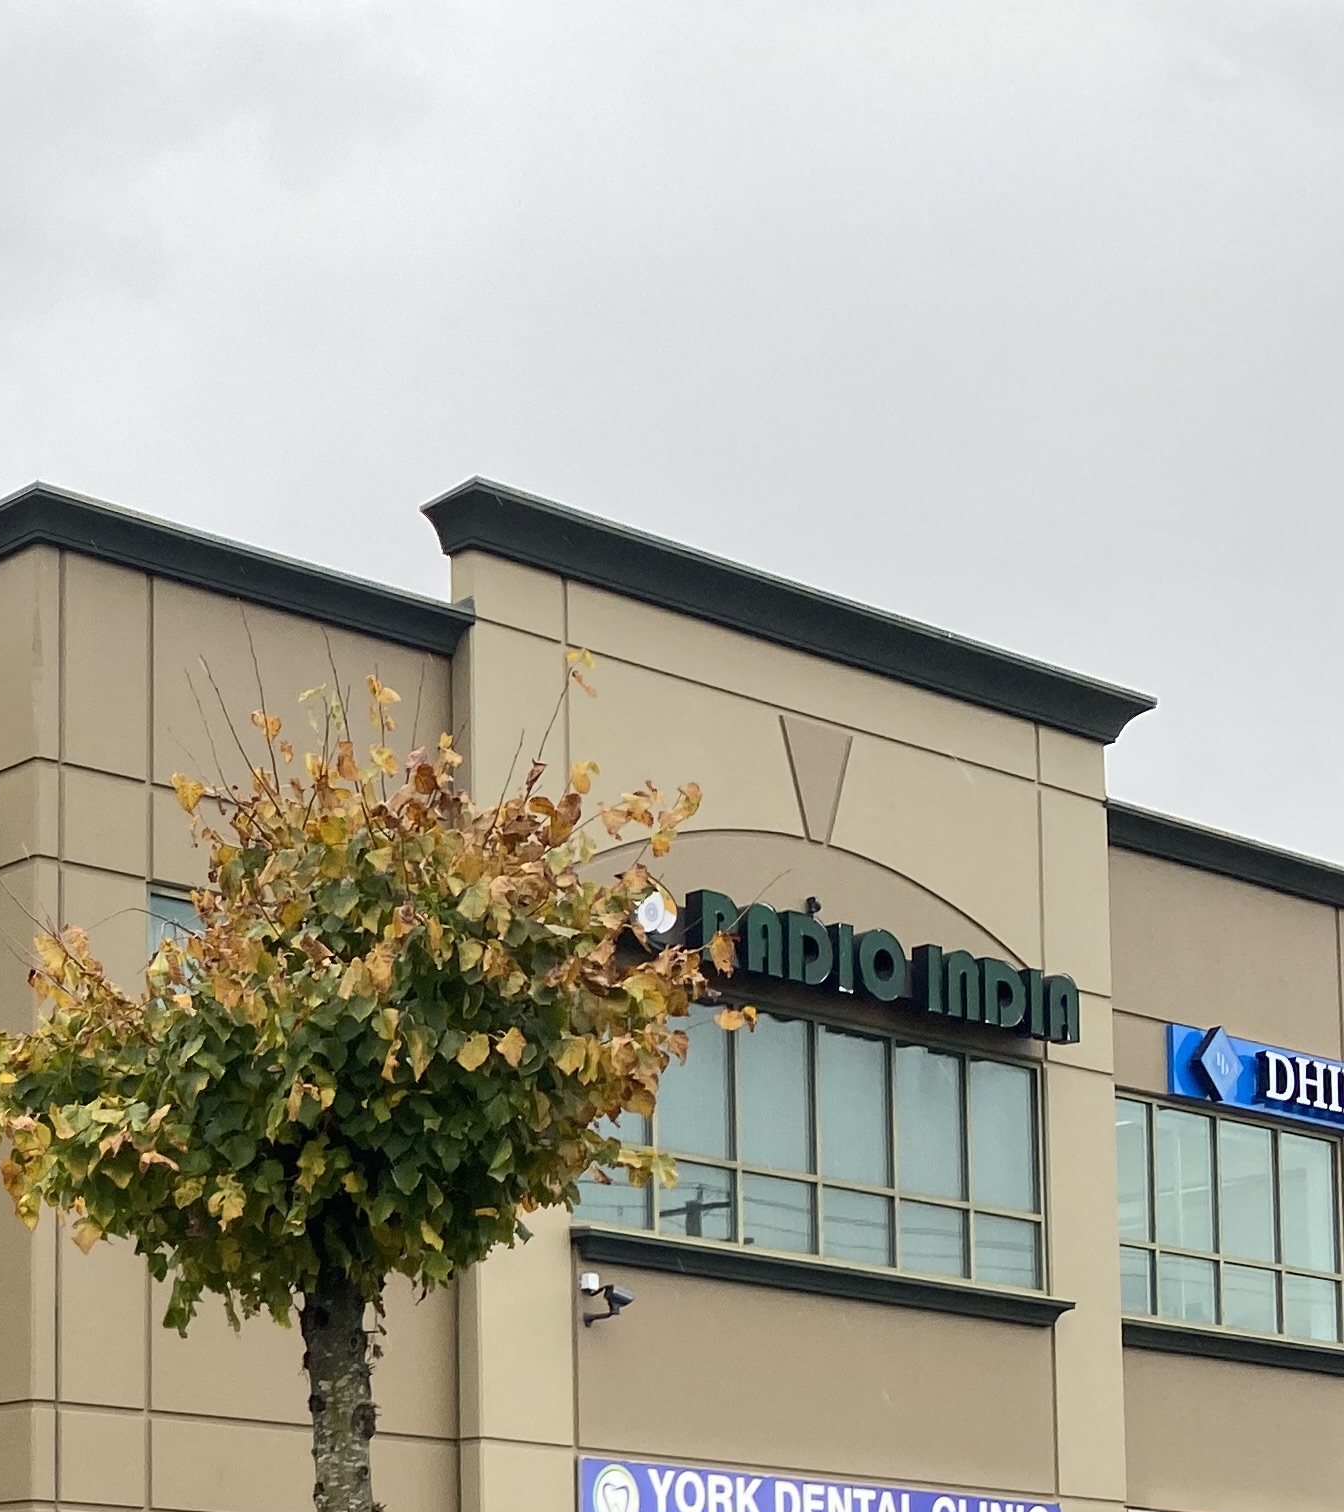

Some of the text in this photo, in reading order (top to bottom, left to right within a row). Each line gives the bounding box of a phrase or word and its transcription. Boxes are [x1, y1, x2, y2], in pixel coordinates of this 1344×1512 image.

[686, 889, 1081, 1044] RADIO INDIA
[1257, 1050, 1344, 1113] DHI
